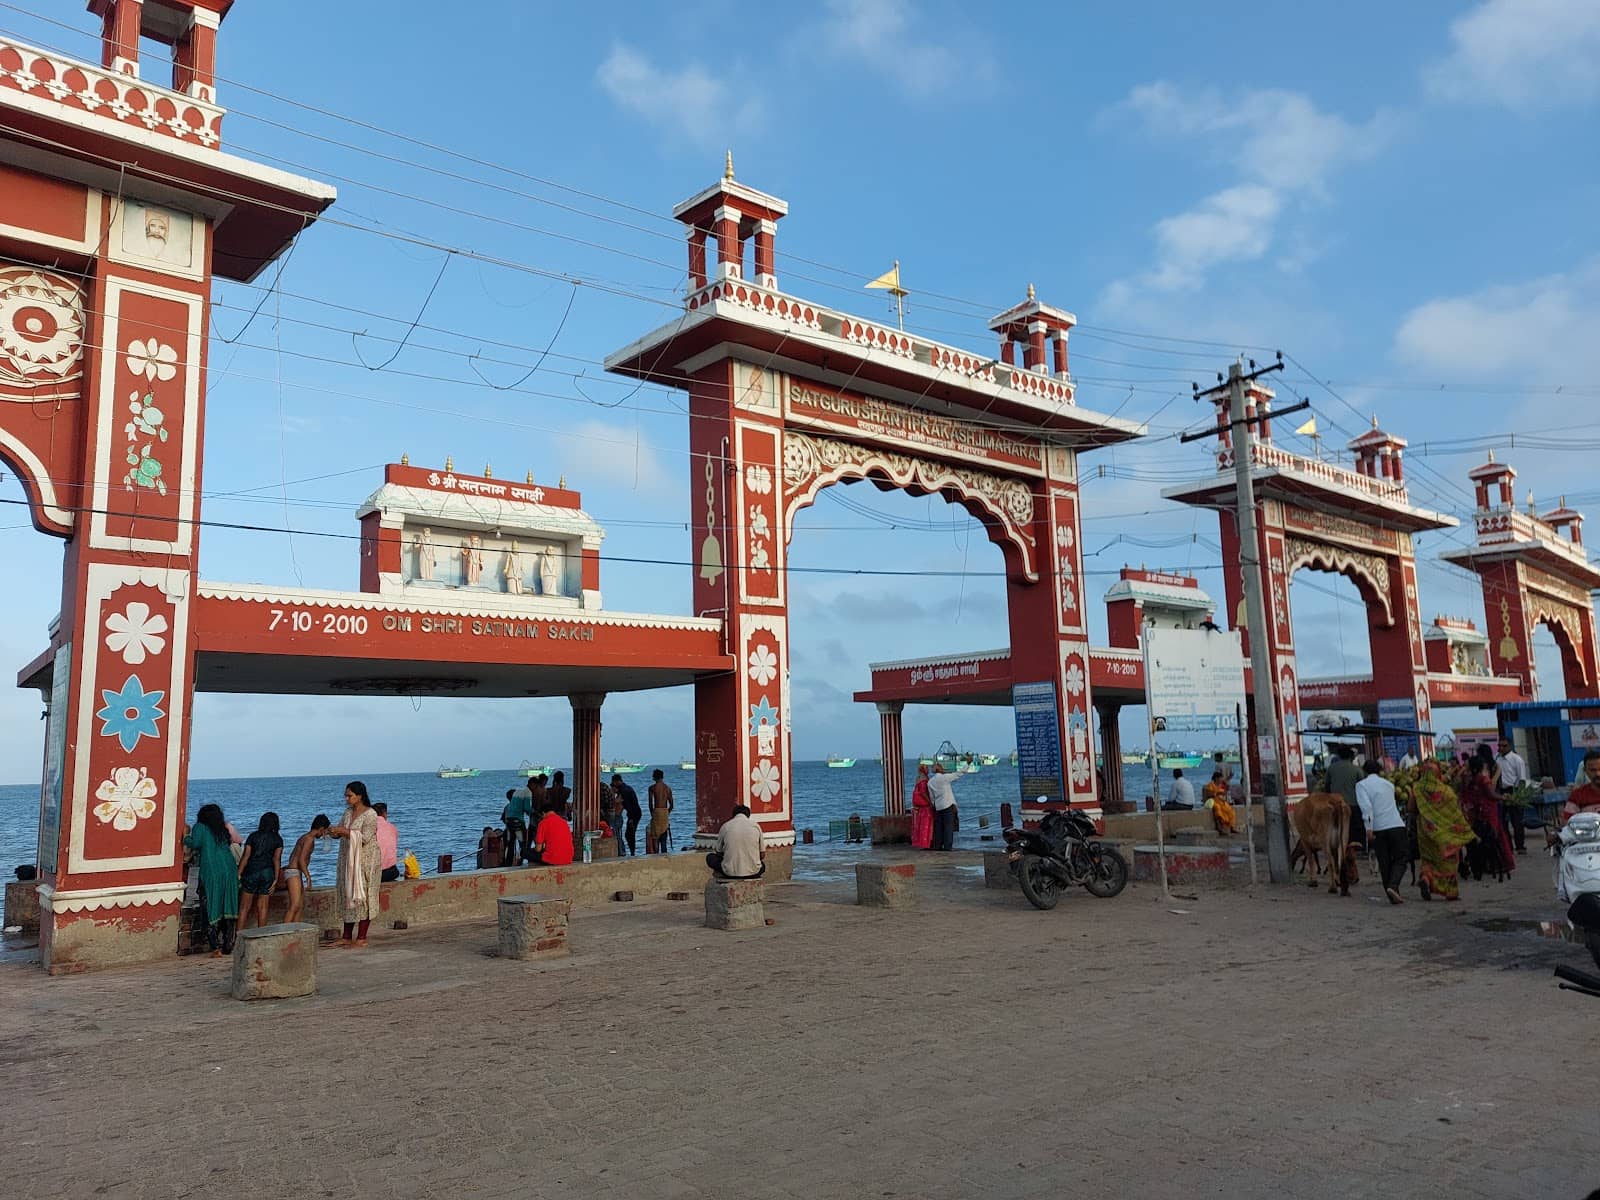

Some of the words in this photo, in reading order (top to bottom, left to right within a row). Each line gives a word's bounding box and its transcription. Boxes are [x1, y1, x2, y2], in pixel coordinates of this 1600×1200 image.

[790, 385, 860, 418] SATGURU
[442, 474, 457, 489] श्री
[382, 615, 412, 632] OM
[421, 617, 463, 634] SHRI
[471, 620, 539, 638] SATNAM
[548, 625, 594, 641] SAKHI
